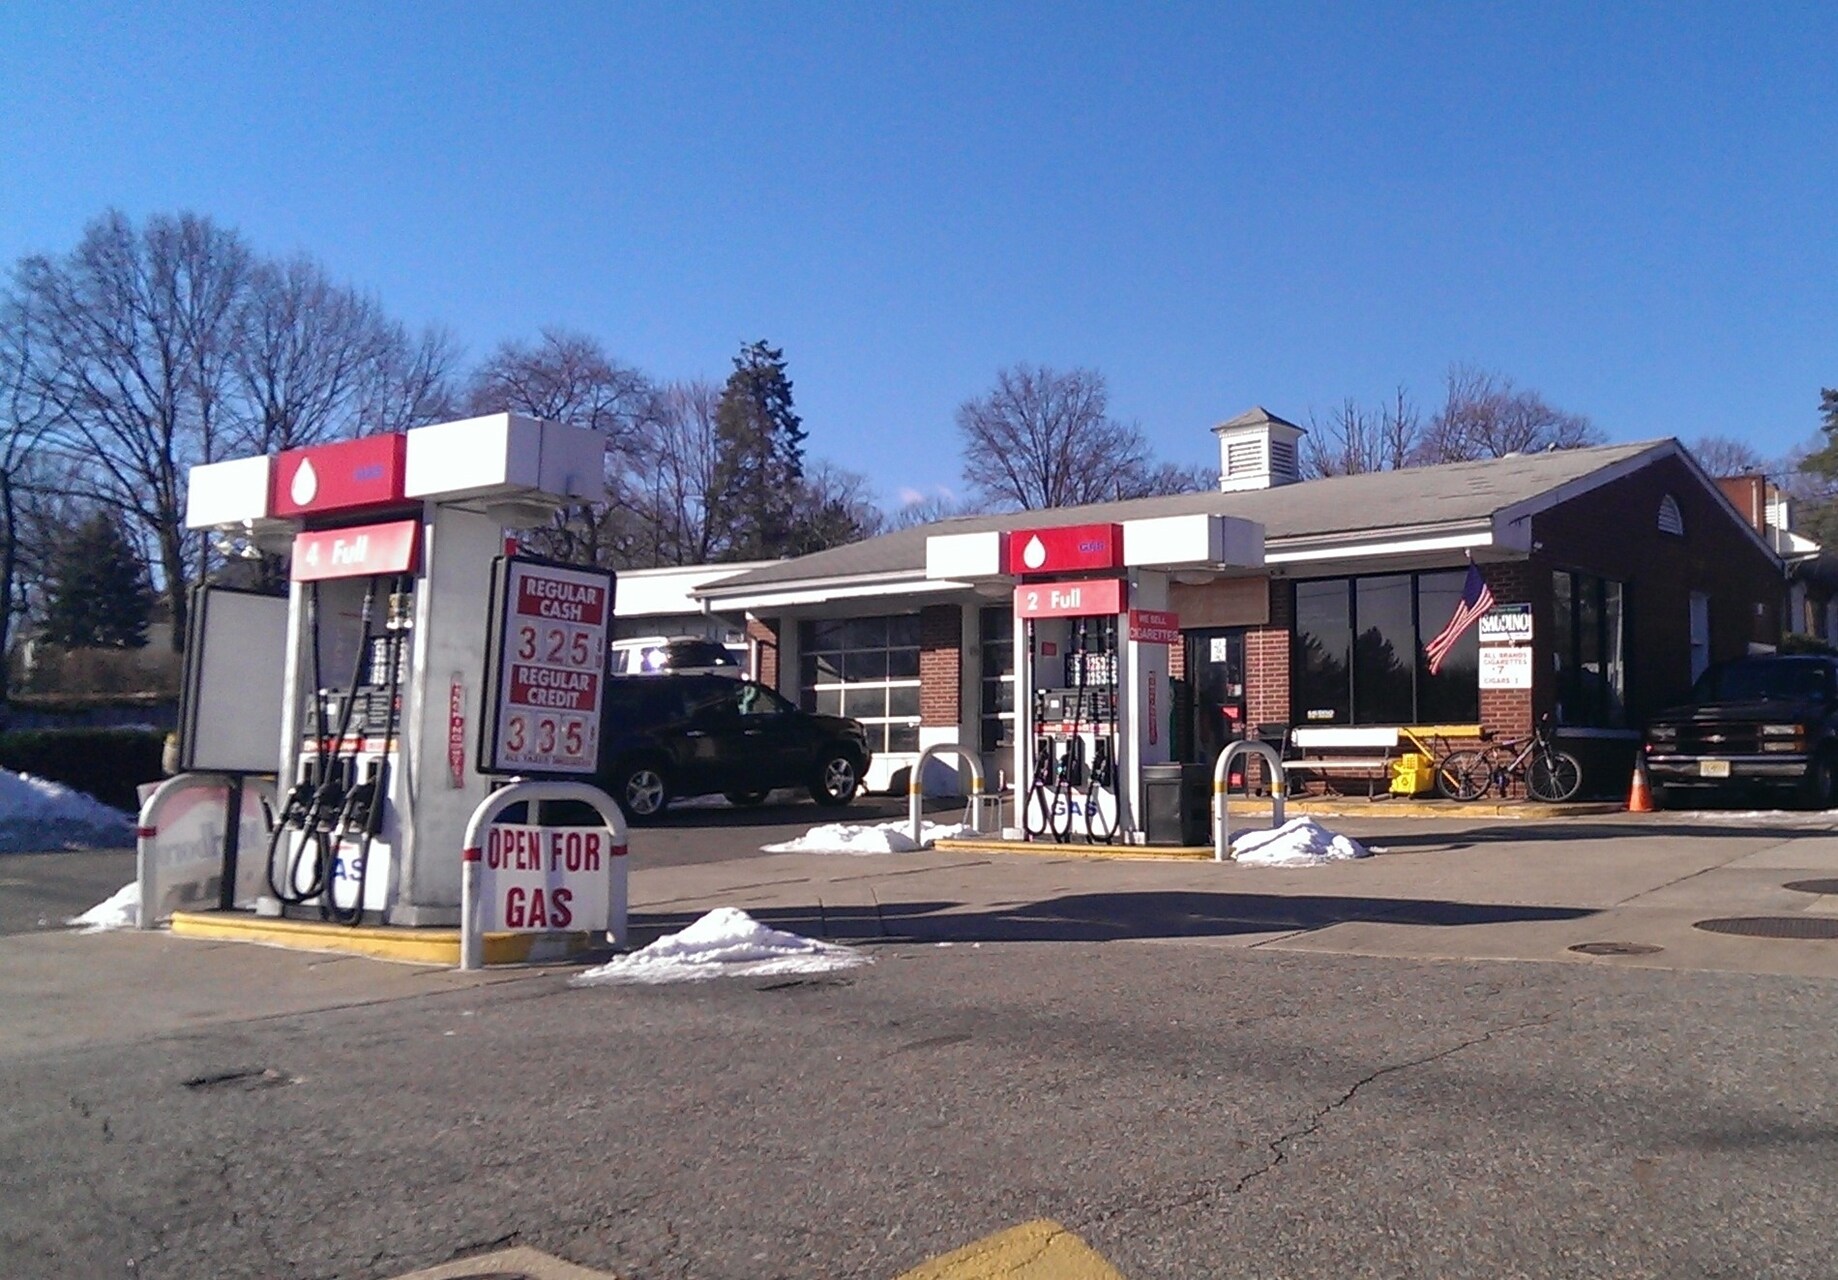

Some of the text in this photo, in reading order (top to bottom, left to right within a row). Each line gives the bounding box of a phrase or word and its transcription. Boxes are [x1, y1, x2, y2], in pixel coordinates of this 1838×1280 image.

[305, 535, 369, 567] 4 Full
[526, 578, 596, 605] REGULAR
[1027, 588, 1081, 610] 2 Full
[540, 600, 582, 621] CASH
[1130, 627, 1178, 641] CIGARETTES
[518, 667, 589, 691] REGULAR
[527, 687, 580, 709] CREDIT
[1052, 801, 1098, 817] GAS
[487, 828, 600, 872] OPEN FOR
[505, 887, 573, 928] GAS
